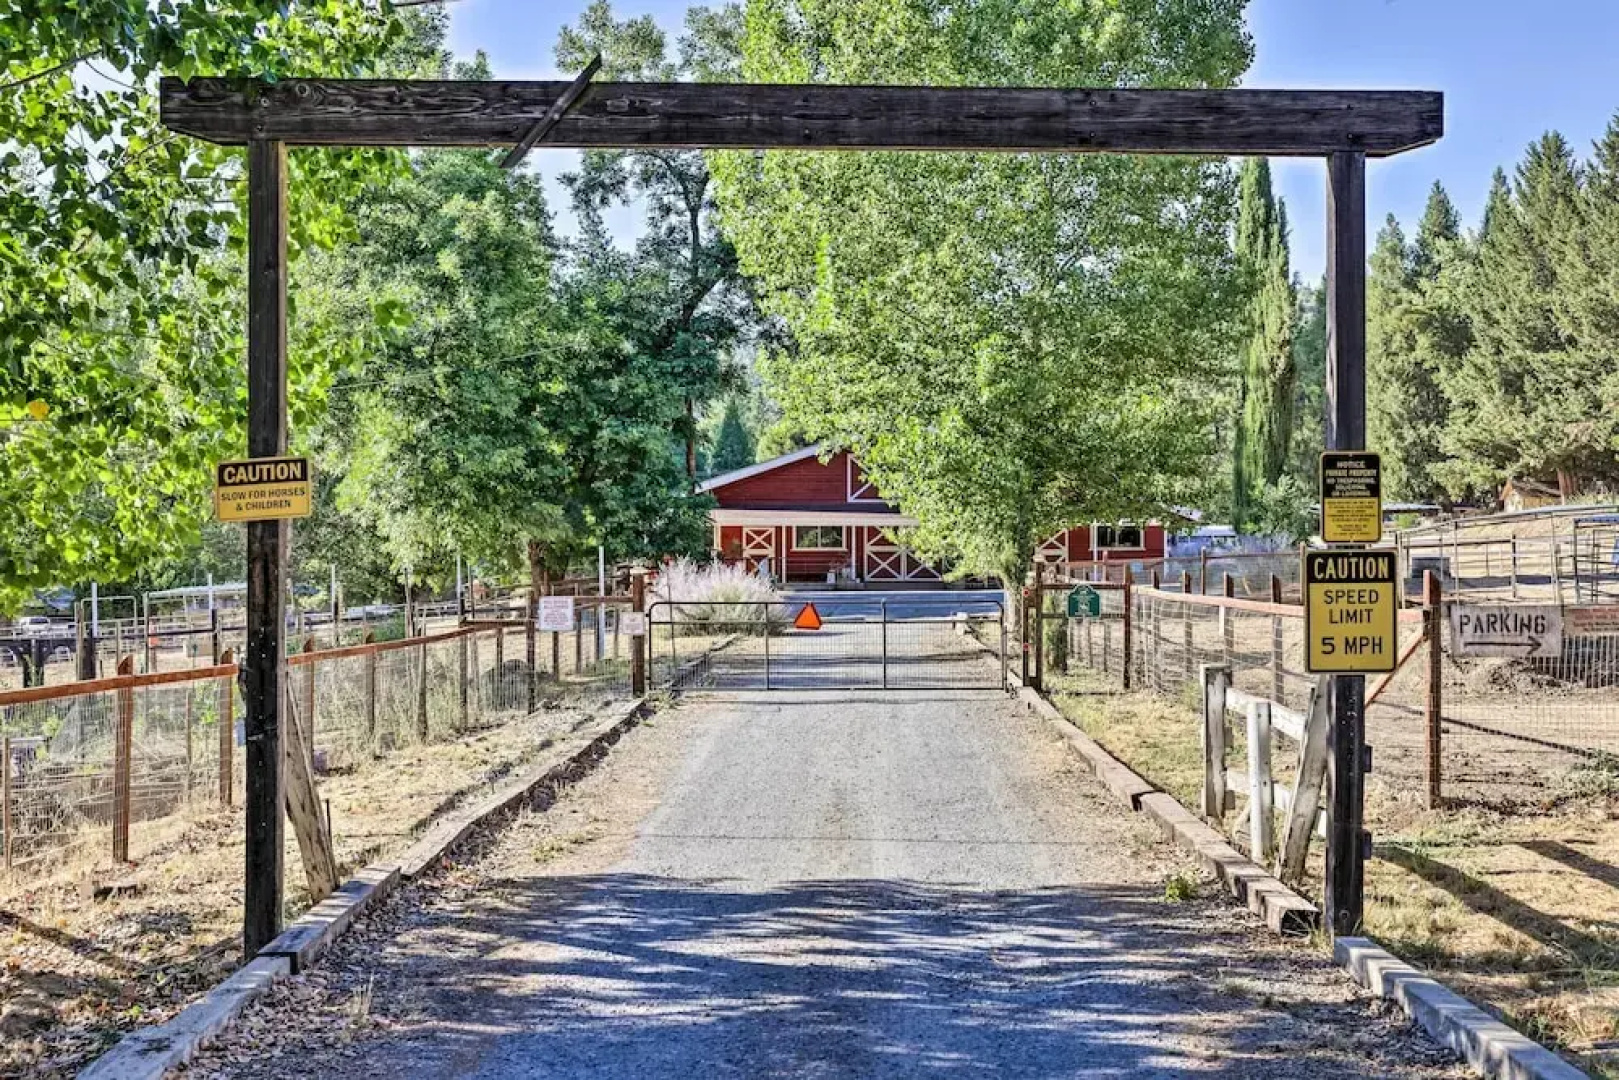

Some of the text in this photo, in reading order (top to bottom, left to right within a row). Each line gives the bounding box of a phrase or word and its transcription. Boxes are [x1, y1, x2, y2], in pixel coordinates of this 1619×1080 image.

[223, 462, 302, 484] CAUTION
[221, 487, 305, 501] SLOW FOR HORSES
[245, 500, 291, 511] CHILDREN
[1314, 557, 1389, 579] CAUTION
[1324, 589, 1379, 605] SPEED
[1329, 608, 1373, 624] LIMIT
[1459, 613, 1546, 635] PARKING
[1321, 636, 1383, 655] 5 MPH
